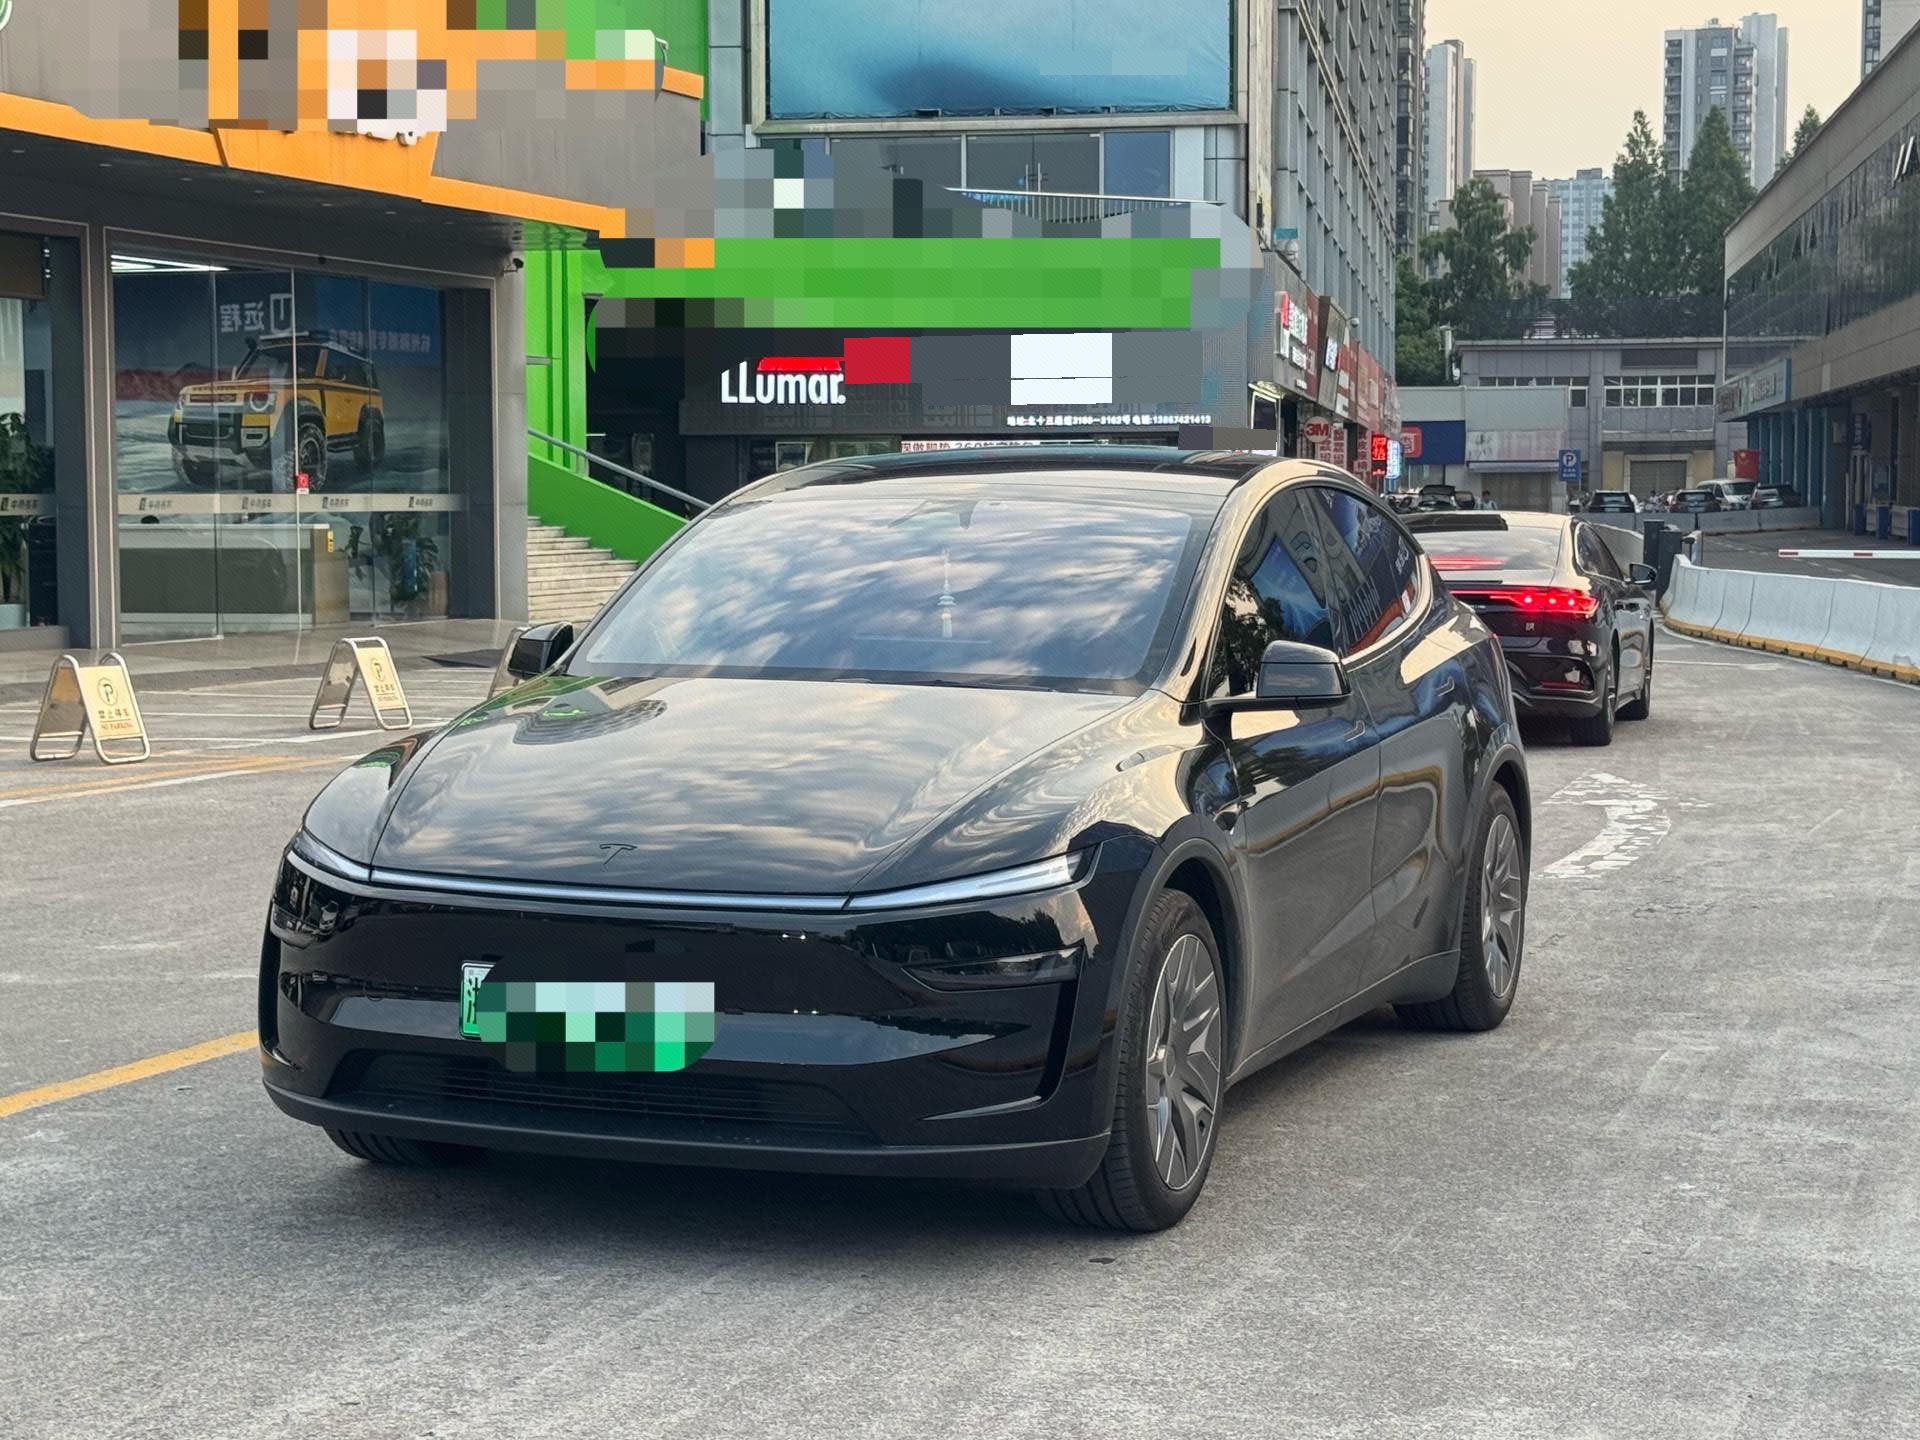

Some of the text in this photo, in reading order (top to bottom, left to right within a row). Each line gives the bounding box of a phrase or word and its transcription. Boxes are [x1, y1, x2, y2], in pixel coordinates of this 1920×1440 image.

[721, 360, 845, 404] LLumar
[1305, 423, 1329, 436] 3M
[1566, 454, 1574, 465] P
